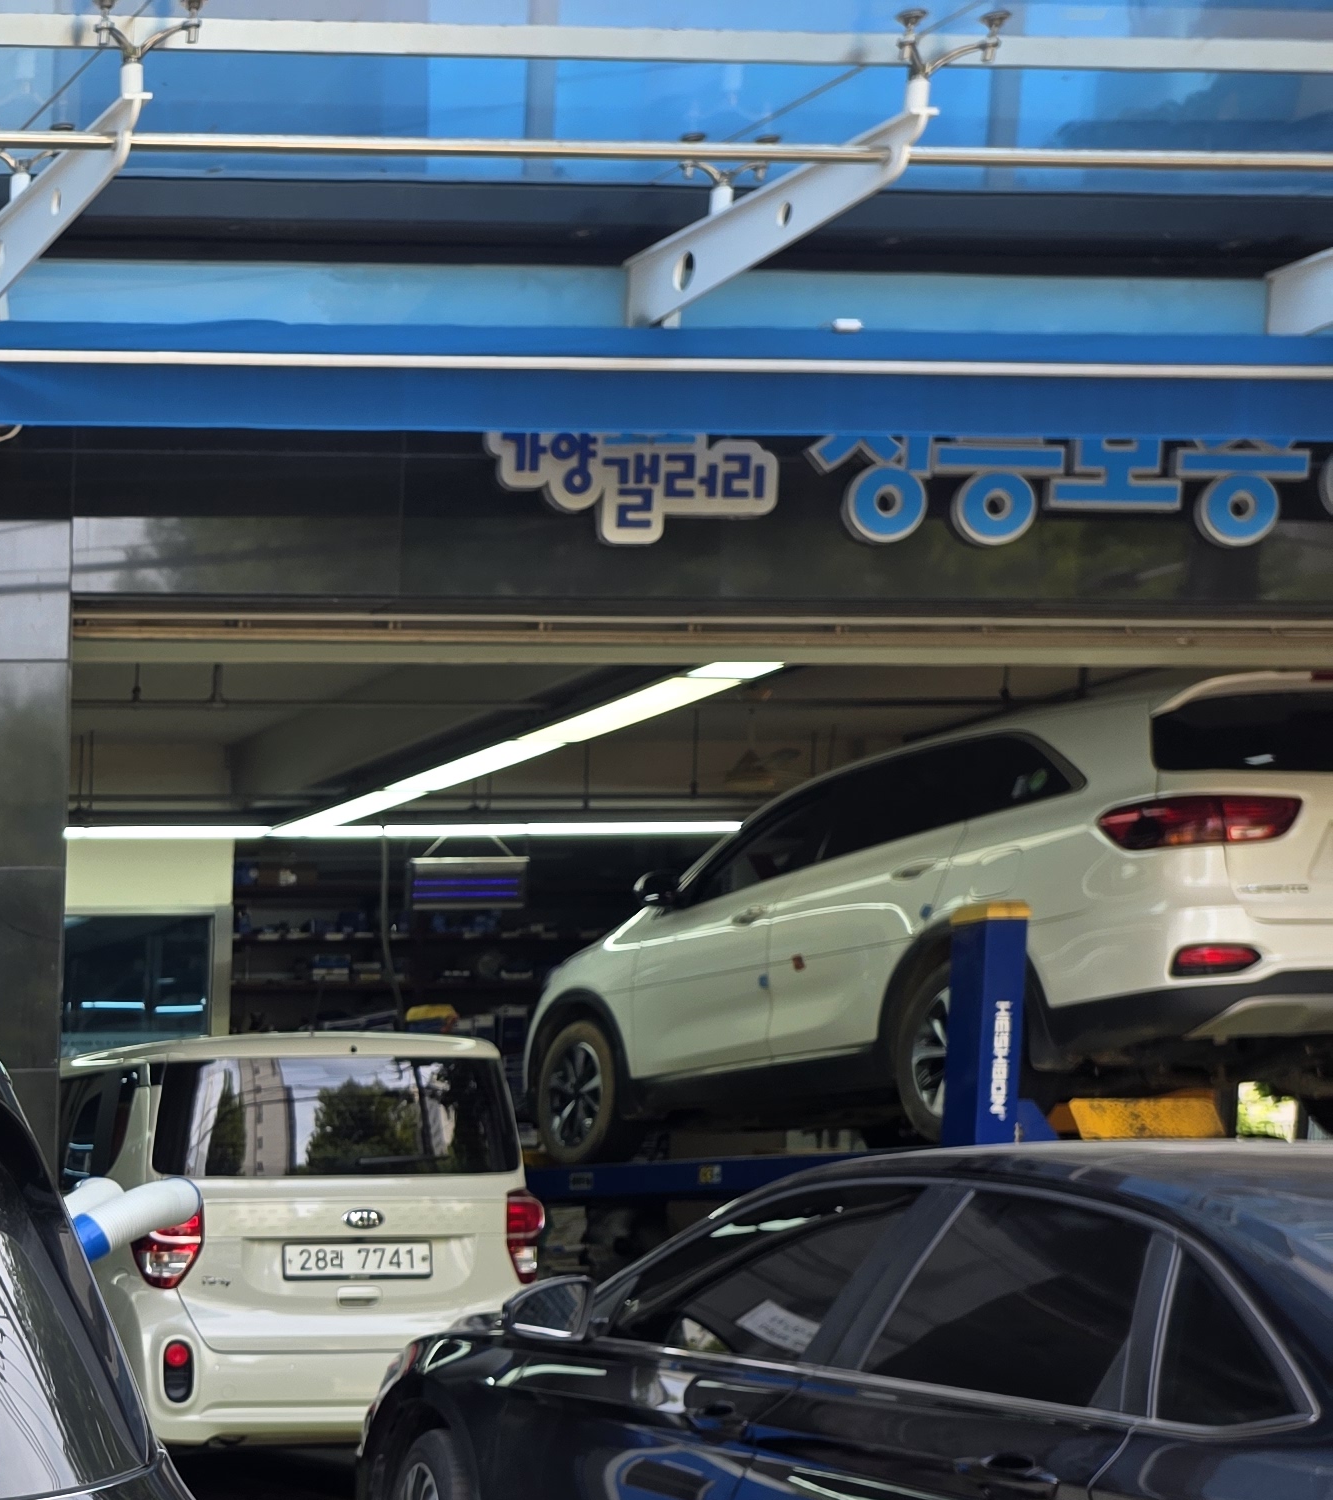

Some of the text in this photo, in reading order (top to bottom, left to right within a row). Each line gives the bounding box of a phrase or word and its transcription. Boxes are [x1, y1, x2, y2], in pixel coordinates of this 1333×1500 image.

[602, 453, 765, 529] 갤러리
[989, 1000, 1012, 1121] HESHBON
[298, 1247, 415, 1271] 28라 7741
